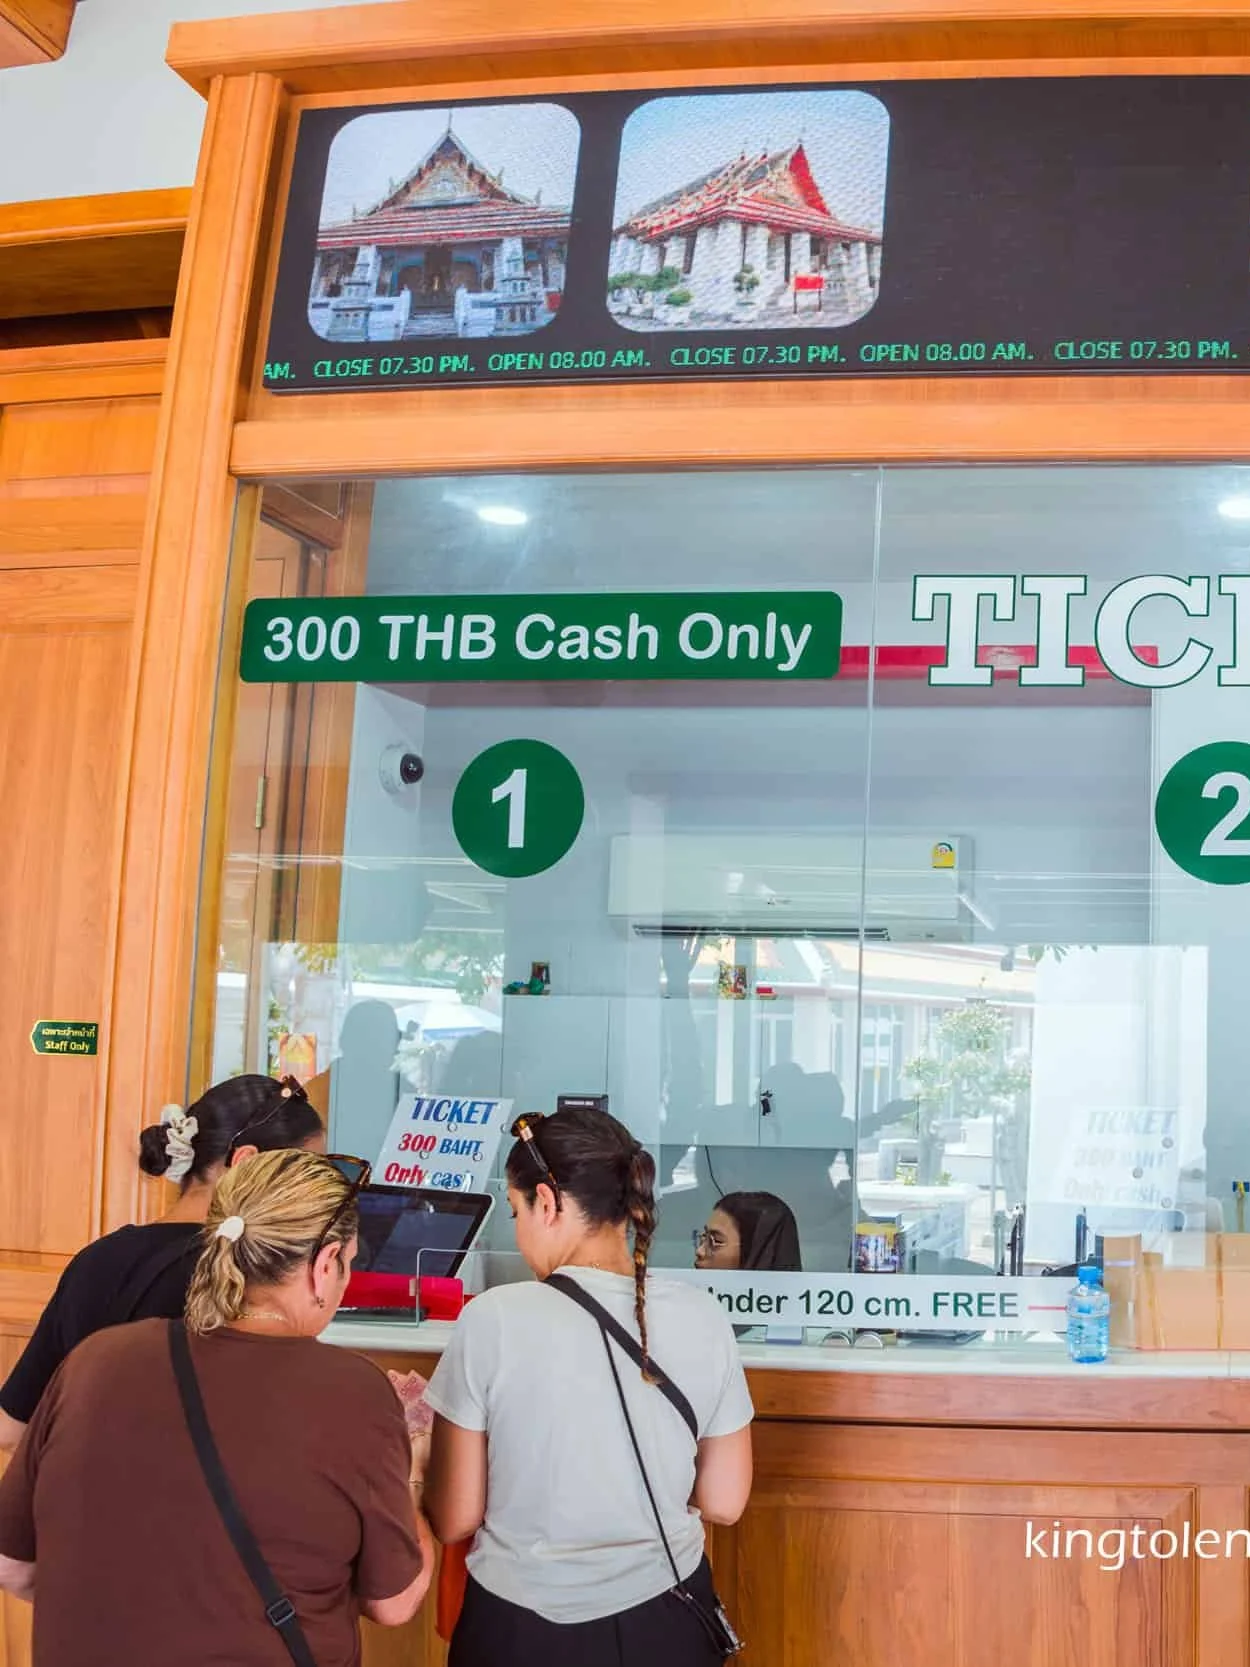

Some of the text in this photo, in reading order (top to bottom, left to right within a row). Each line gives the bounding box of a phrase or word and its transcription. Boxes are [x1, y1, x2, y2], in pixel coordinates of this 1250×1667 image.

[313, 356, 374, 377] CLOSE
[379, 354, 434, 375] 07.30
[439, 353, 476, 373] PM.
[488, 352, 545, 372] OPEN
[549, 350, 607, 369] 08.00
[611, 349, 650, 368] AM.
[670, 347, 735, 366] CLOSE
[742, 346, 801, 365] 07.30
[808, 345, 846, 363] PM.
[860, 344, 920, 362] OPEN
[926, 343, 986, 361] 08.00
[992, 343, 1034, 361] AM.
[1055, 342, 1122, 360] CLOSE
[1130, 341, 1191, 359] 07.30
[1198, 341, 1238, 358] PM.
[263, 613, 812, 671] 300 THB Cash Only
[491, 768, 528, 849] 1
[45, 1040, 89, 1053] Staff Only
[412, 1097, 499, 1125] TICKET
[399, 1132, 484, 1157] 300 BAHT
[385, 1162, 426, 1187] Only
[708, 1286, 1019, 1318] nder 120 cm. FREE
